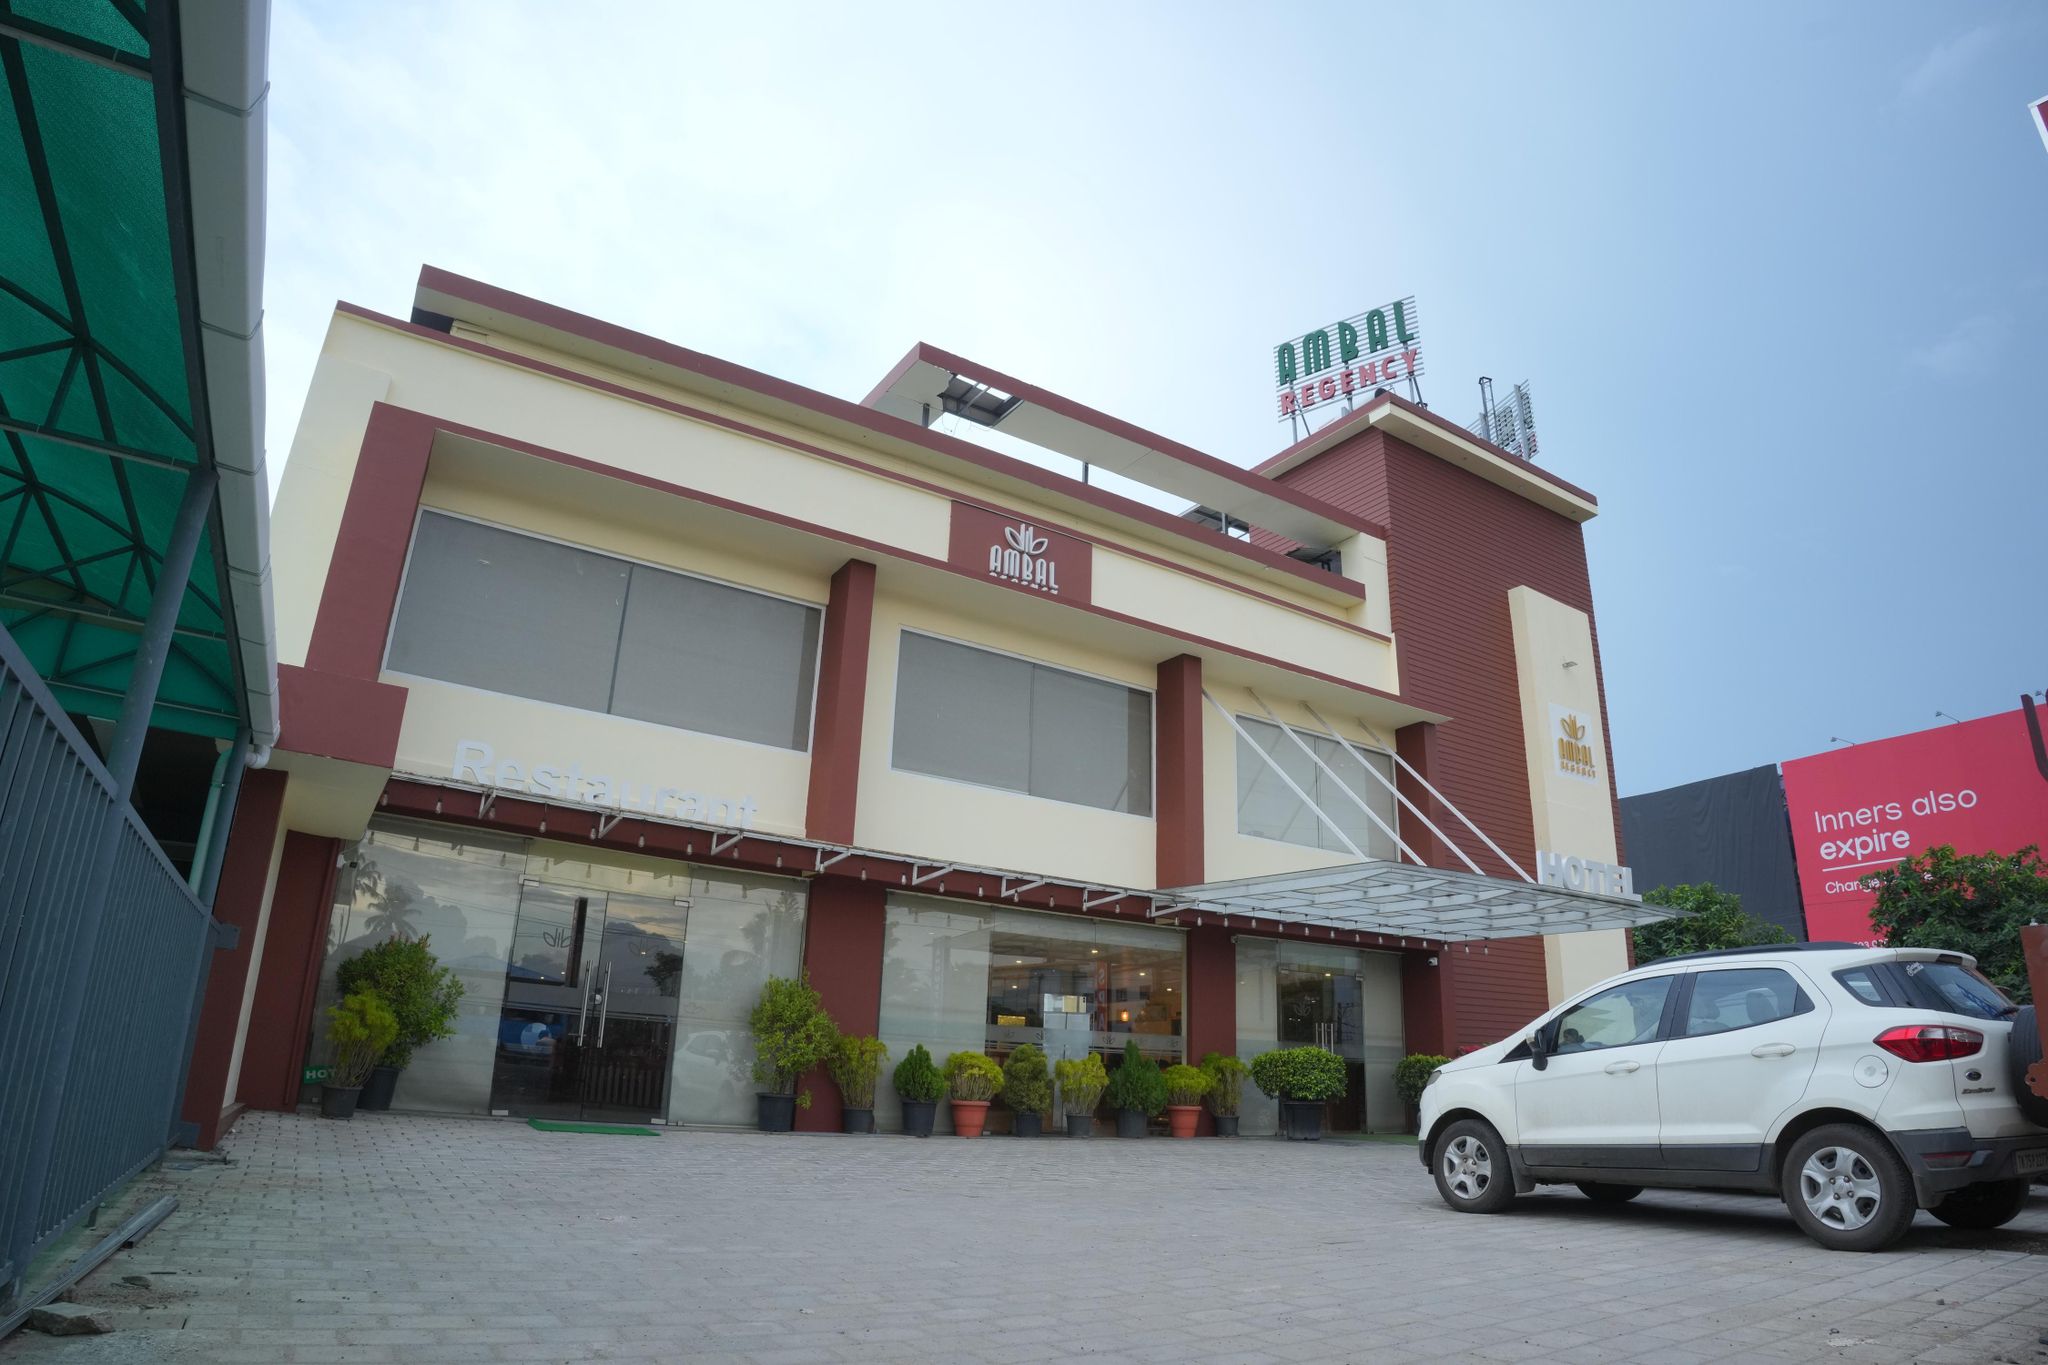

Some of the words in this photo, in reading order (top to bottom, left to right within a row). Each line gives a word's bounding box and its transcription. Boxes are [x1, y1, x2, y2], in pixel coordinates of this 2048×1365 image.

[1277, 300, 1415, 386] AMBAL
[1279, 348, 1418, 417] REGENCY
[989, 544, 1059, 589] AMBAL
[450, 738, 758, 830] Restaurant
[1814, 801, 1903, 833] Inners
[1911, 789, 1978, 816] also
[1820, 828, 1911, 860] expire
[1536, 850, 1643, 902] HOTEL
